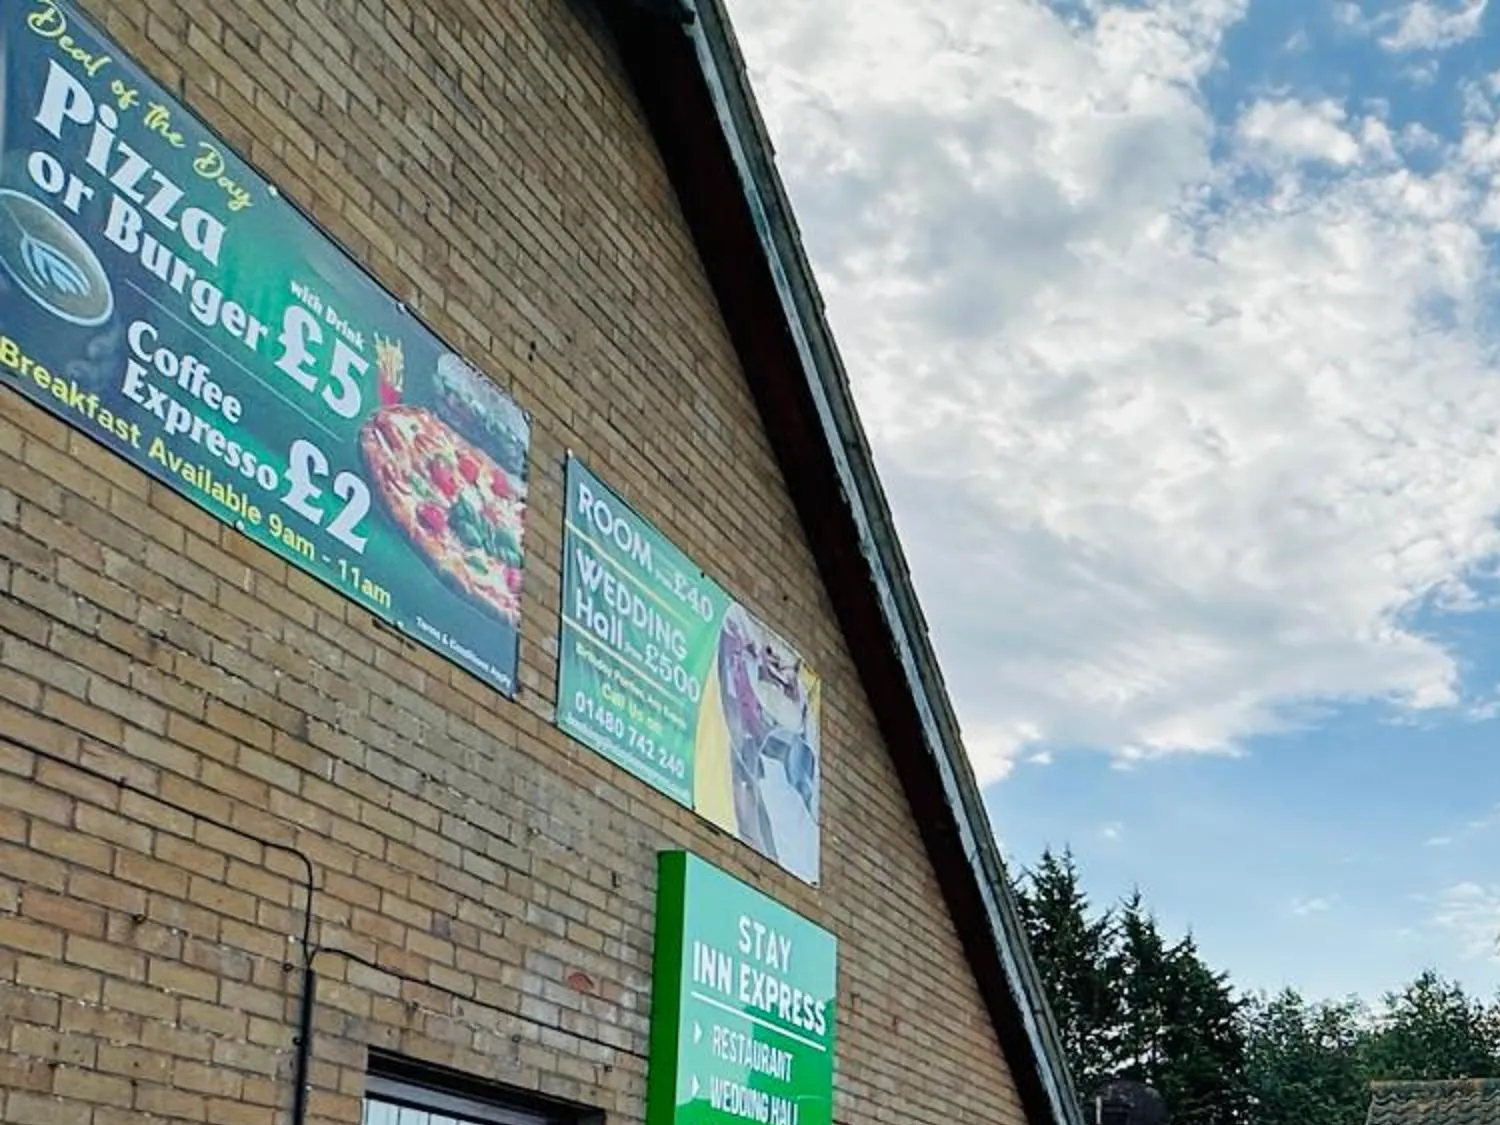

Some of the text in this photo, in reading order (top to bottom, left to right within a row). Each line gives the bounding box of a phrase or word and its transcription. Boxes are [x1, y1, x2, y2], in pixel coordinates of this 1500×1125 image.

[34, 57, 227, 268] Pizza
[111, 79, 140, 110] of
[193, 141, 254, 212] Day
[28, 151, 269, 351] or Burger
[274, 304, 370, 419] £5
[290, 279, 366, 350] with Drink
[121, 358, 279, 491] Expresso
[127, 320, 243, 424] Coffee
[0, 336, 142, 449] Breakfast
[148, 436, 262, 526] Available
[268, 513, 316, 562] 9am
[338, 559, 392, 608] 11am
[280, 439, 372, 555] £2
[578, 482, 653, 573] ROOM
[575, 587, 623, 650] Hall
[645, 643, 701, 703] £500
[576, 548, 688, 661] WEDDING
[692, 940, 826, 1036] INN EXPRESS
[738, 914, 792, 972] STAY
[710, 1075, 769, 1123] WEDDING
[711, 1024, 793, 1082] RESTAURANT
